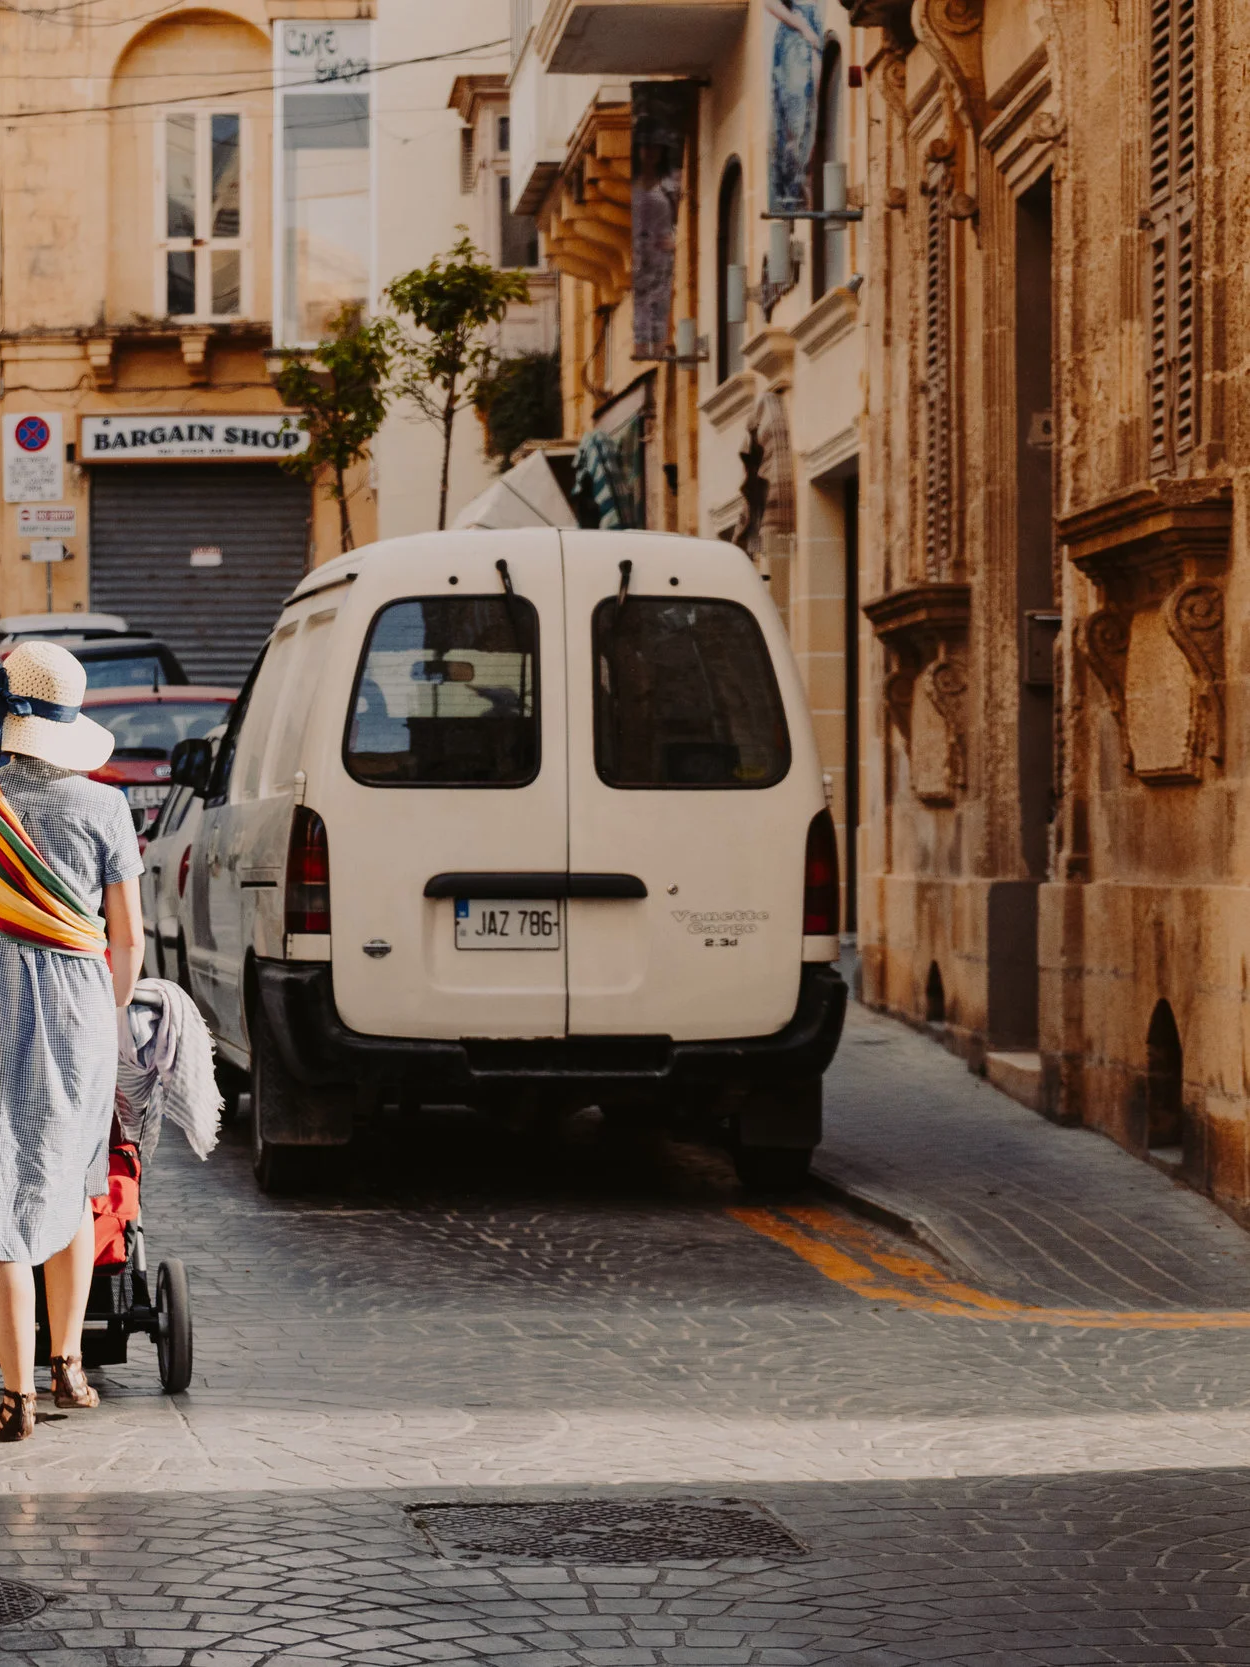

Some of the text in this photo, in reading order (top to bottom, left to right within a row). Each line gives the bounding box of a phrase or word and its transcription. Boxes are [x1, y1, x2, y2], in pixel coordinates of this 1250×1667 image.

[94, 424, 300, 451] BARGAIN SHOP
[475, 910, 553, 936] JAZ 786
[670, 910, 770, 923] Vanette
[687, 921, 758, 935] Cargo
[704, 938, 739, 947] 2.3d
